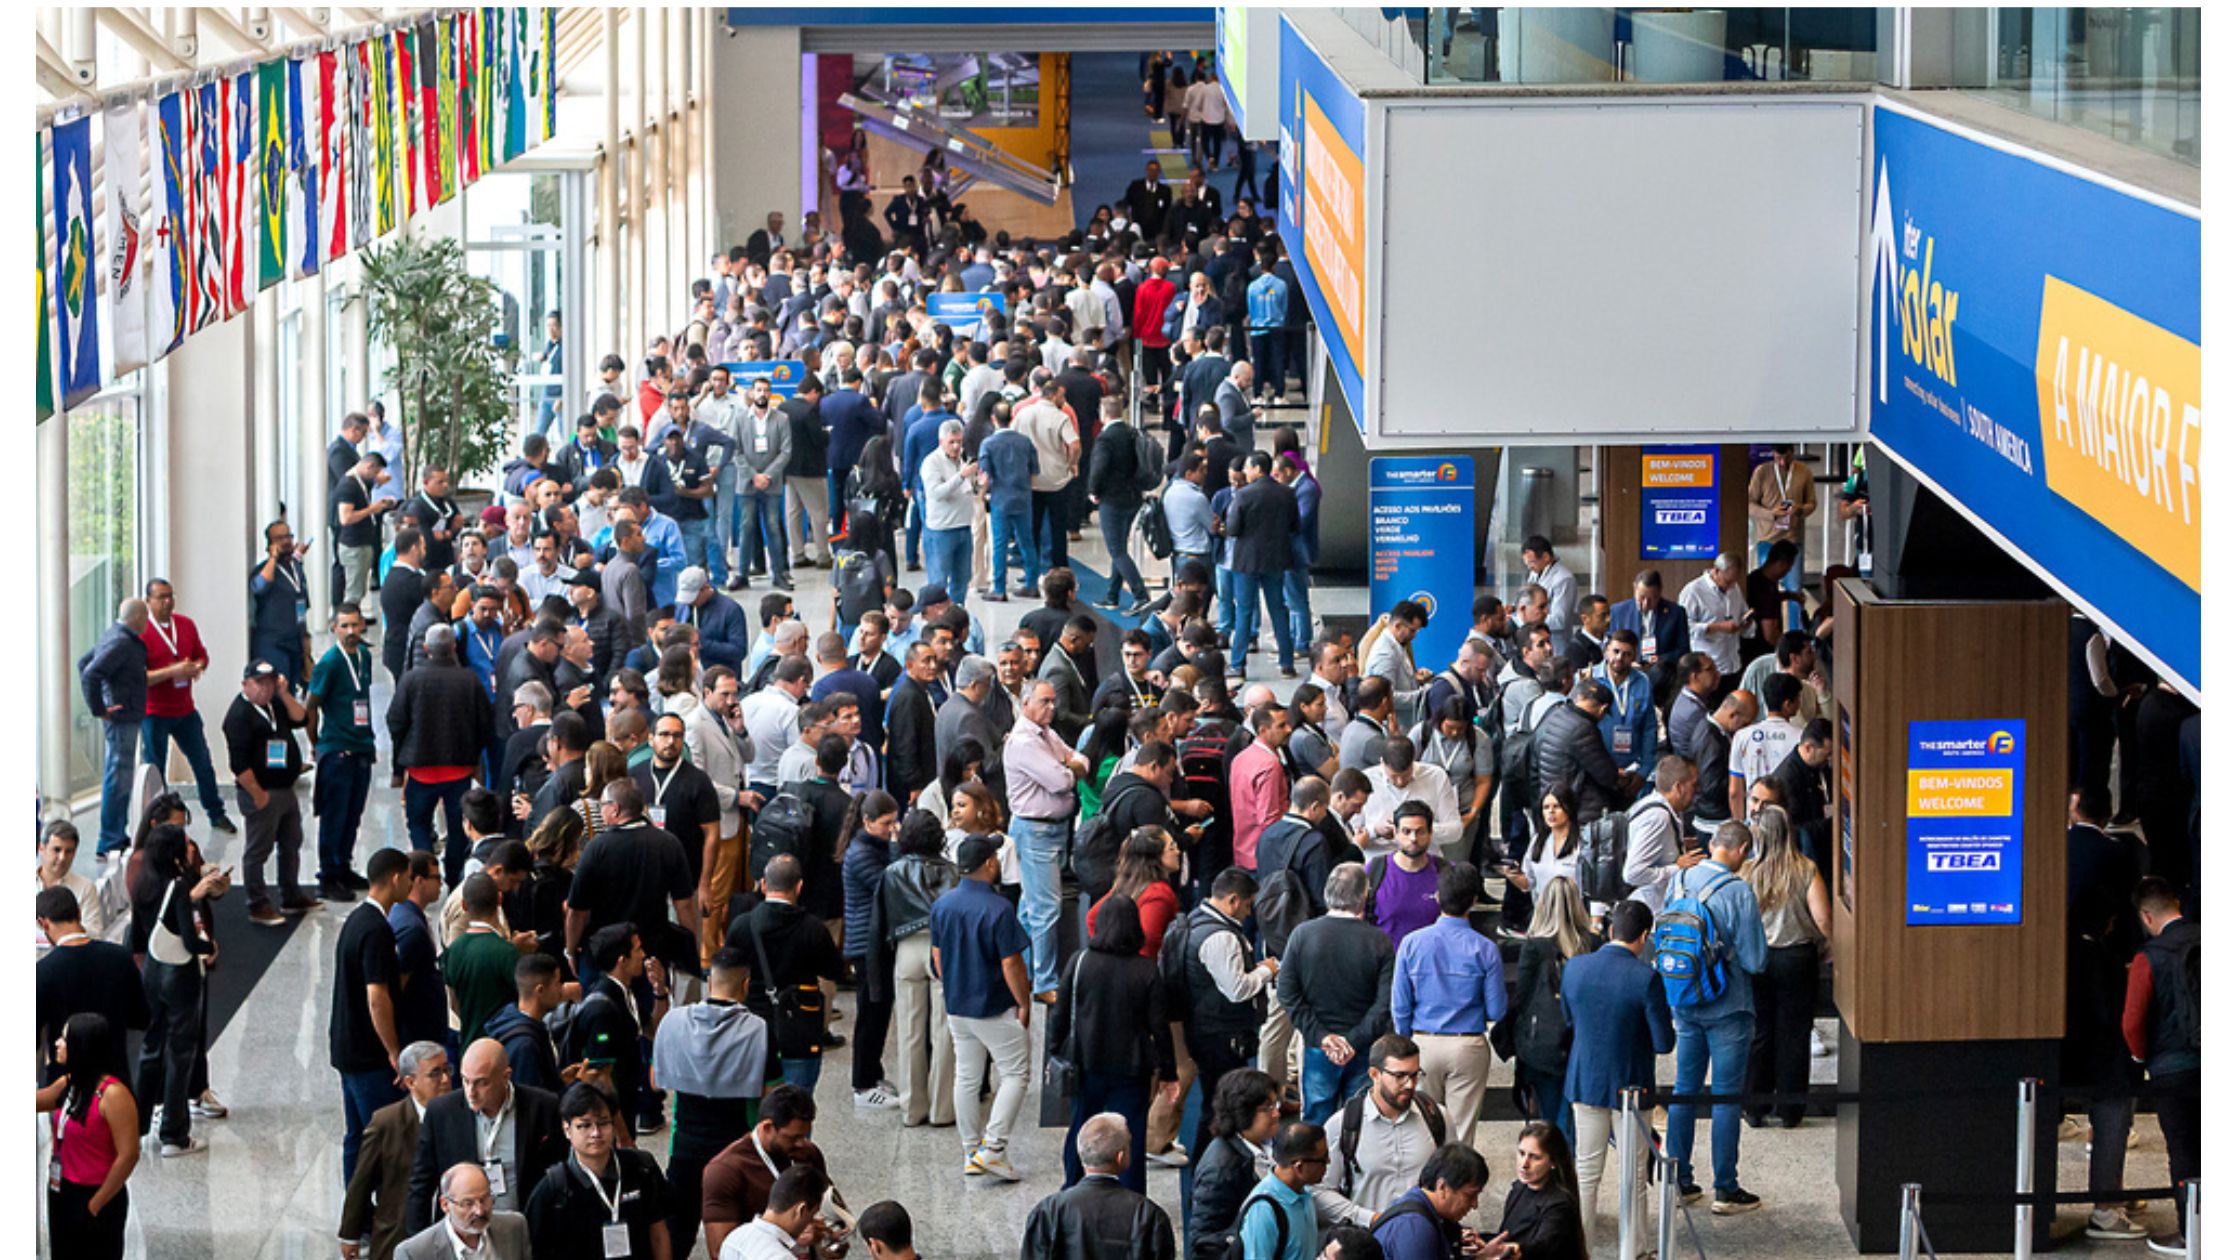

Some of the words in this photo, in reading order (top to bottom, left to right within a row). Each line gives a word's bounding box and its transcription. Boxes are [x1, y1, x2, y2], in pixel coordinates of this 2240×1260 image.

[2054, 335, 2074, 448] A
[2076, 346, 2174, 513] MAIOR
[2178, 401, 2201, 525] F
[1994, 421, 2033, 476] AMERICA
[1650, 460, 1707, 469] BEM-VINDOS
[1649, 473, 1695, 482] WELCOME
[1404, 505, 1420, 513] AOS
[1375, 516, 1408, 525] BRANCO
[1375, 526, 1401, 534] VERDE
[1375, 534, 1420, 543] VERMELHO
[1919, 776, 2004, 790] BEM-VINDOS
[1918, 796, 1985, 810] WELCOME
[1931, 853, 1997, 868] TBEA
